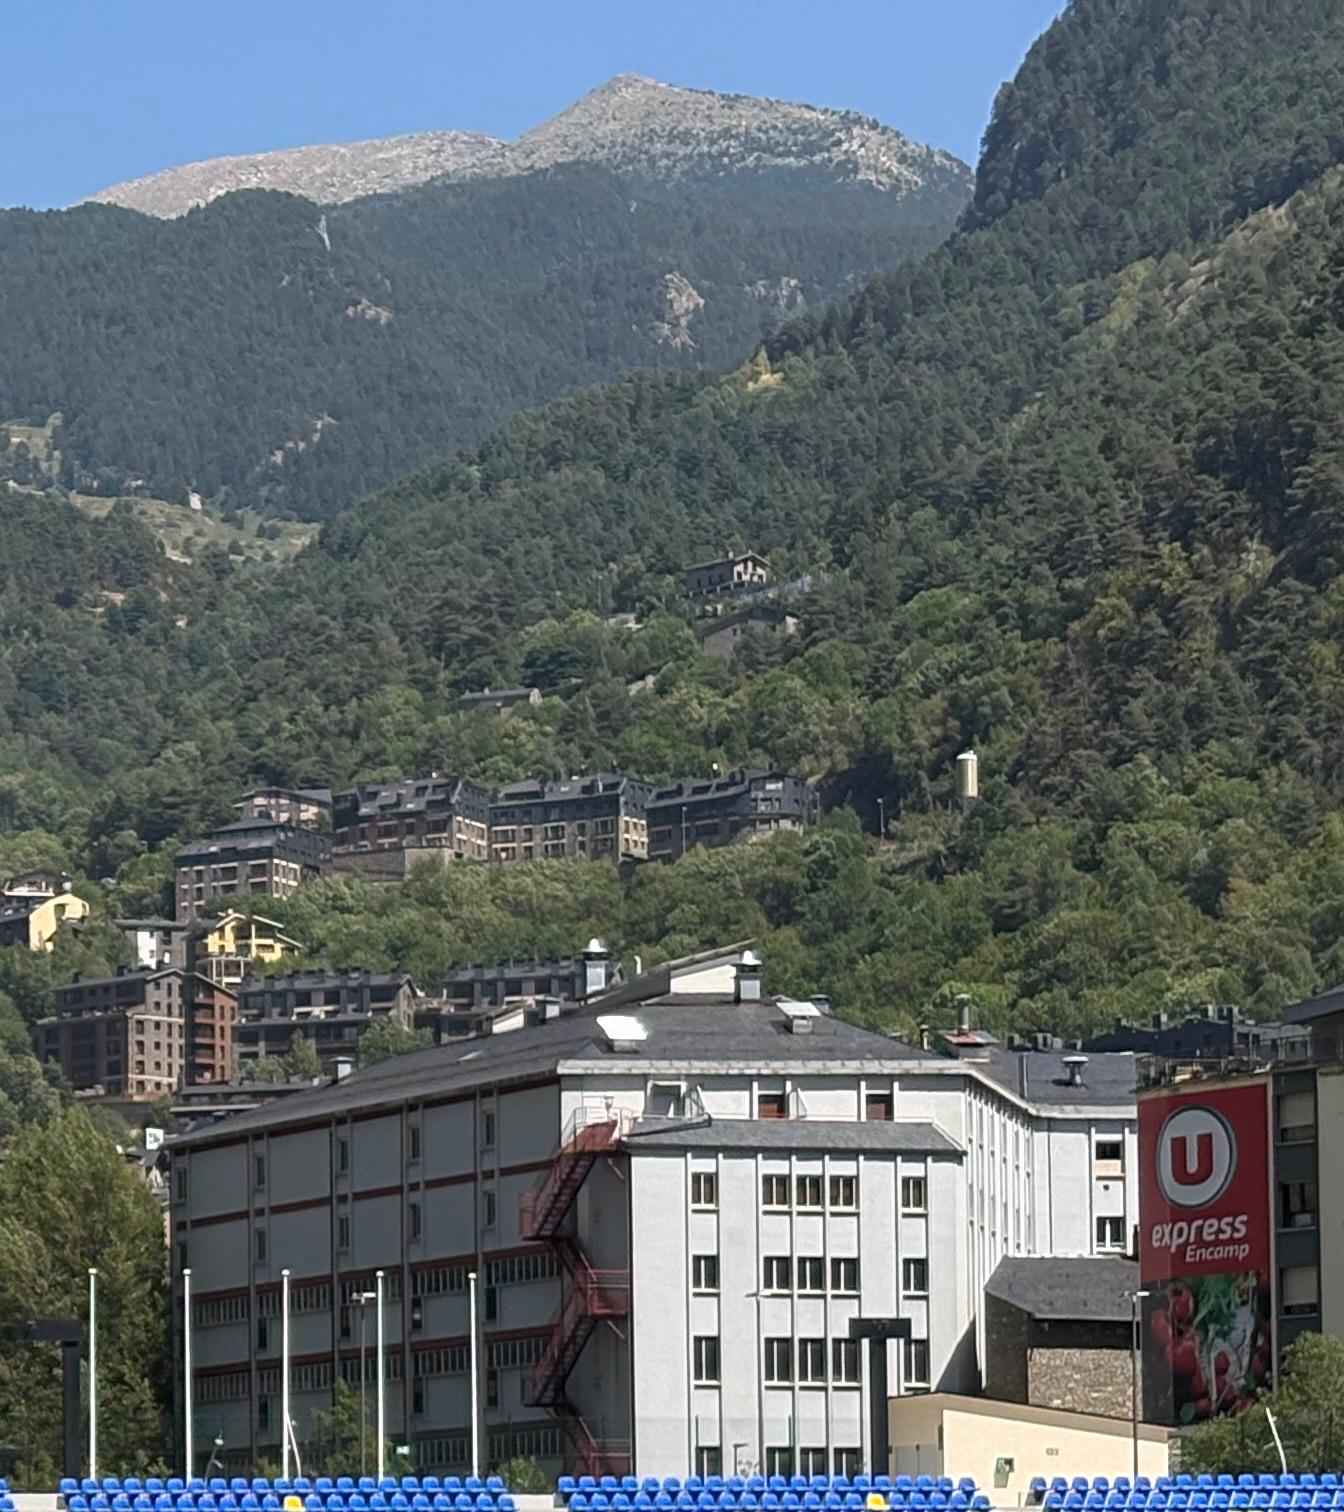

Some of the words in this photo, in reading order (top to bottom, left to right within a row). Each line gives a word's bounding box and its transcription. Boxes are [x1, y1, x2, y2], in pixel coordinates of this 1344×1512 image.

[1170, 1133, 1213, 1186] U
[1152, 1214, 1248, 1254] express
[1185, 1243, 1250, 1263] Encamp
